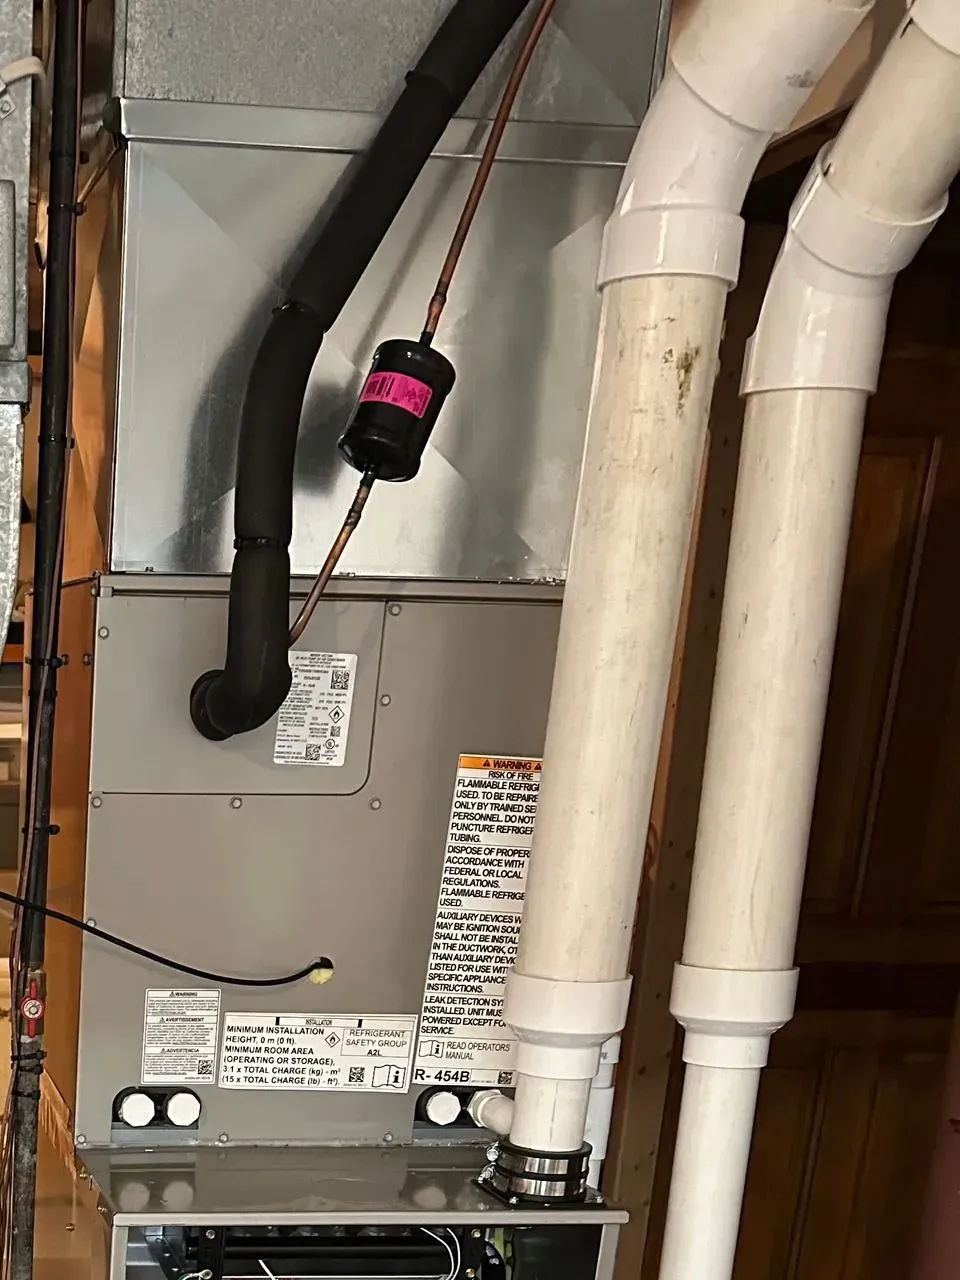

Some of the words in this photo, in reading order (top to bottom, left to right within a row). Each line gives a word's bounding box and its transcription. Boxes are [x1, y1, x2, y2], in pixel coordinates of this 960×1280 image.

[494, 760, 531, 770] WARNING
[458, 779, 507, 790] FLAMMABLE
[456, 790, 480, 799] USED.
[482, 792, 492, 800] TO
[494, 792, 505, 800] BE
[455, 801, 476, 809] ONLY
[477, 802, 488, 810] BY
[490, 803, 524, 812] TRAINED
[505, 815, 516, 823] DO
[518, 815, 535, 824] NOT
[451, 822, 495, 832] PUNCTURE
[450, 833, 481, 842] TUBING.
[447, 845, 482, 855] DISPOSE
[484, 848, 495, 856] OF
[446, 856, 502, 867] ACCORDANCE
[504, 860, 524, 868] WITH
[444, 867, 481, 876] FEDERAL
[482, 869, 495, 877] OR
[496, 870, 523, 879] LOCAL
[443, 877, 500, 888] REGULATIONS.
[441, 888, 490, 898] FLAMMABLE
[440, 898, 463, 907] USED.
[437, 912, 479, 920] AUXILIARY
[480, 914, 514, 923] DEVICES
[436, 922, 453, 930] MAY
[454, 923, 465, 931] BE
[466, 924, 500, 933] IGNITION
[434, 932, 460, 941] SHALL
[433, 942, 441, 950] IN
[442, 943, 457, 951] THE
[458, 944, 506, 955] DUCTWORK,
[432, 953, 453, 961] THAN
[453, 954, 494, 963] AUXILIARY
[430, 963, 456, 971] LISTED
[458, 964, 474, 972] FOR
[475, 965, 491, 973] USE
[428, 973, 462, 982] SPECIFIC
[463, 974, 507, 984] APPLIANCE
[427, 983, 483, 993] INSTRUCTIONS.
[425, 996, 446, 1004] LEAK
[447, 997, 490, 1006] DETECTION
[423, 1006, 466, 1015] INSTALLED.
[468, 1008, 485, 1016] UNIT
[422, 1016, 461, 1025] POWERED
[462, 1018, 492, 1026] EXCEPT
[266, 1027, 324, 1035] INSTALLATION
[349, 1029, 406, 1038] REFRIGERANT
[421, 1026, 455, 1035] SERVICE.
[226, 1036, 258, 1044] HEIGHT,
[446, 1041, 466, 1049] READ
[468, 1042, 510, 1052] OPERATORS
[224, 1056, 274, 1064] (OPERATING
[291, 1057, 335, 1066] STORAGE),
[445, 1052, 474, 1060] MANUAL
[308, 1068, 323, 1076] (kg)
[415, 1069, 431, 1081] R-
[434, 1070, 470, 1082] 454B
[222, 1075, 234, 1083] (15
[308, 1077, 320, 1085] (lb)
